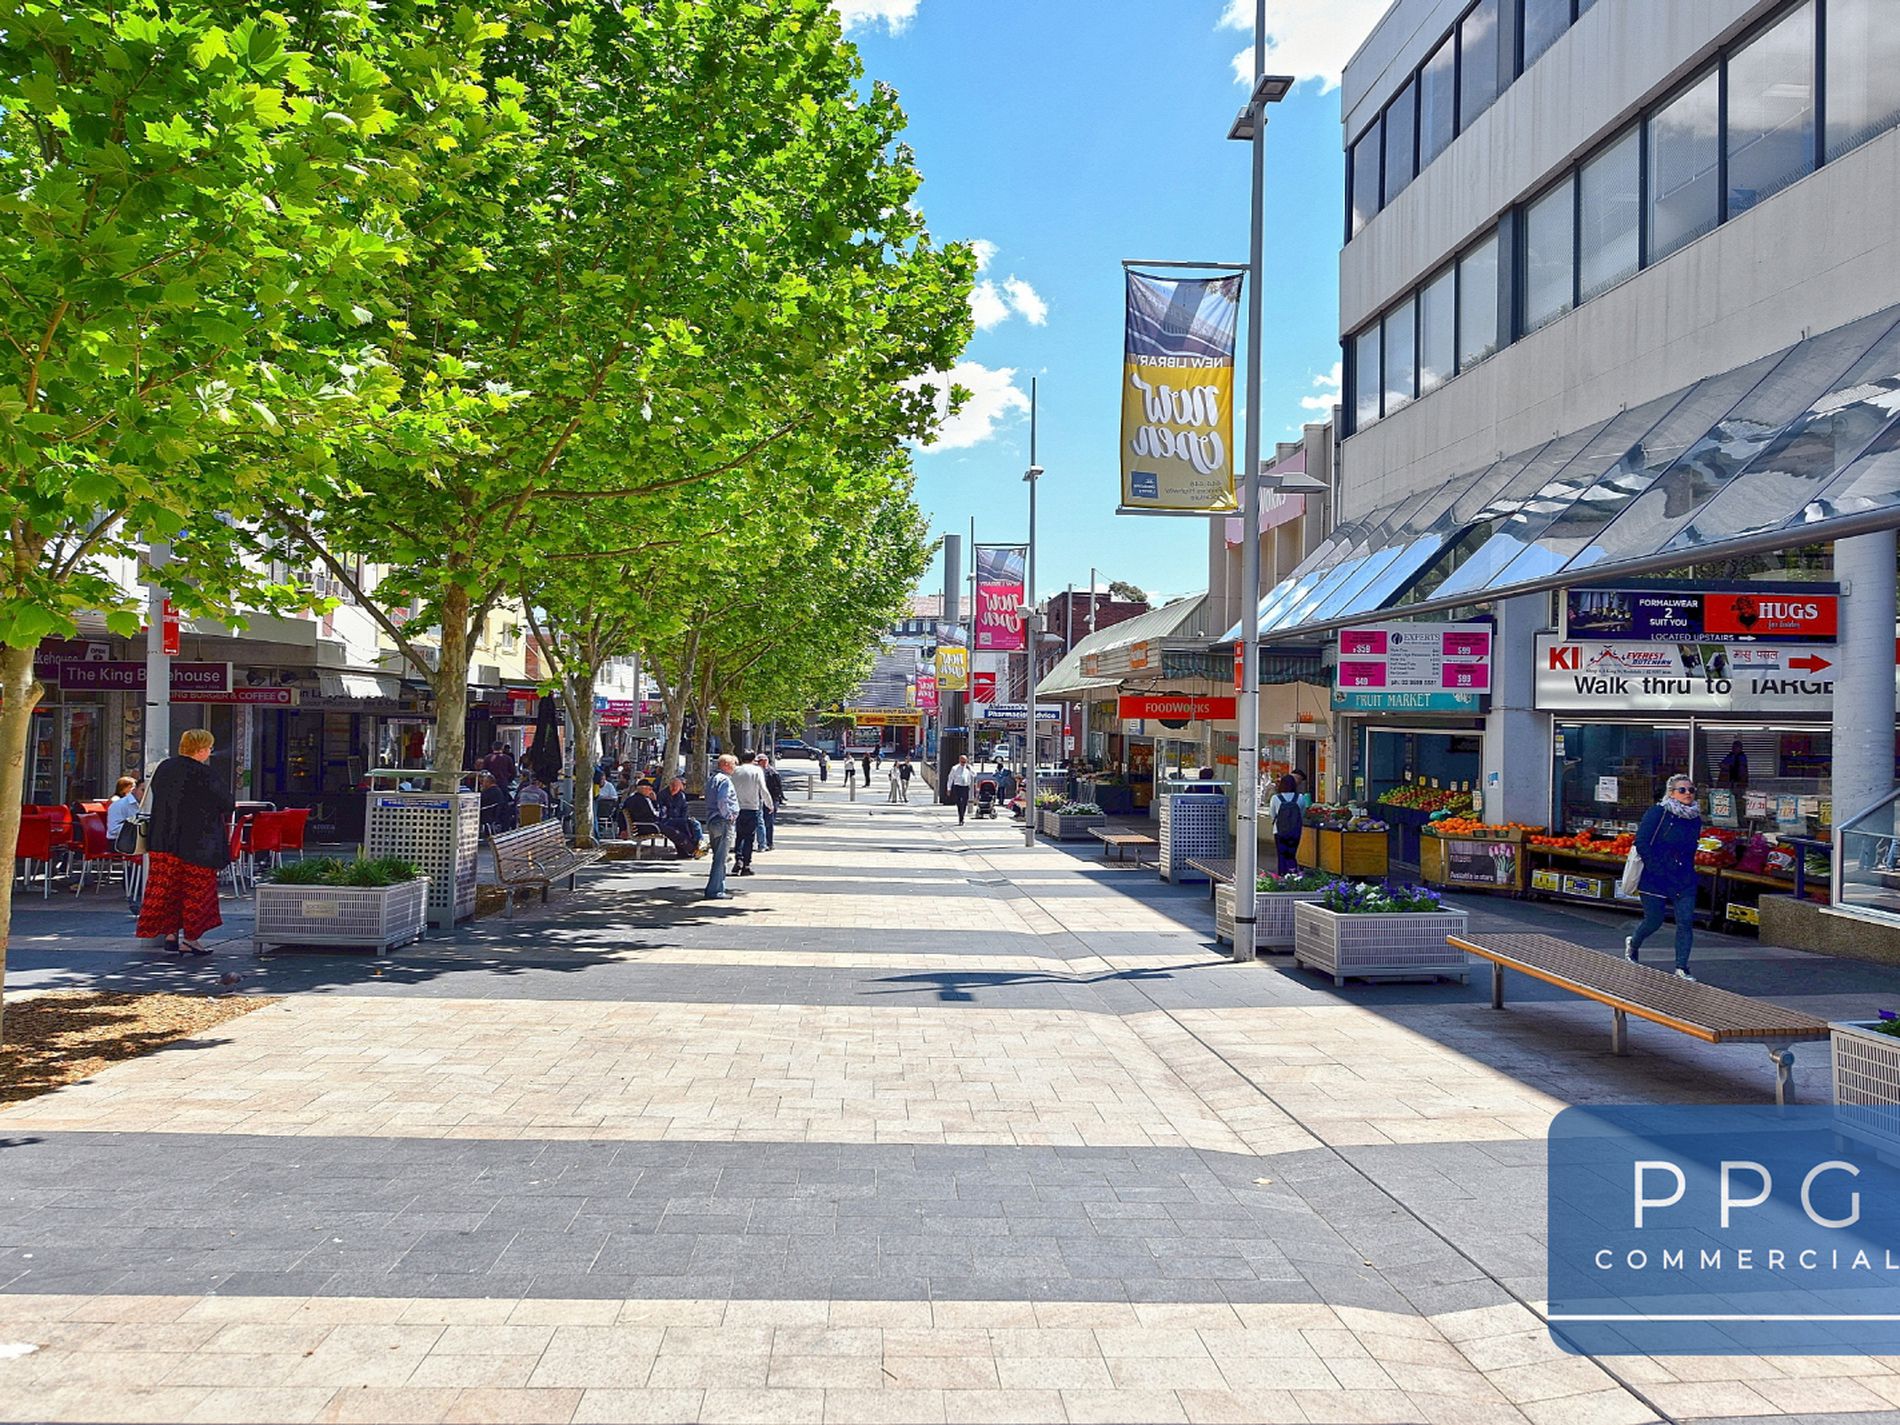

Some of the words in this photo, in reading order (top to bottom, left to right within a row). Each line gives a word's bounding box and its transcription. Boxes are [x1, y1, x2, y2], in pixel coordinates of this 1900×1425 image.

[1639, 599, 1698, 608] FORMALWEAR
[1664, 608, 1673, 618] 2
[1758, 602, 1818, 619] HUGS
[1626, 652, 1665, 660] EVEREST
[67, 668, 96, 681] The
[100, 667, 133, 685] King
[137, 668, 220, 683] Behouse
[1574, 675, 1629, 694] Walk
[1643, 677, 1691, 694] thru
[1705, 677, 1732, 694] to
[170, 692, 188, 700] ING
[190, 692, 229, 700] BURGER
[238, 692, 277, 700] COFFEE
[1355, 694, 1381, 707] FRUIT
[1387, 694, 1431, 707] MARKET
[1145, 702, 1210, 713] FOODWORKS
[1035, 711, 1056, 719] dvice
